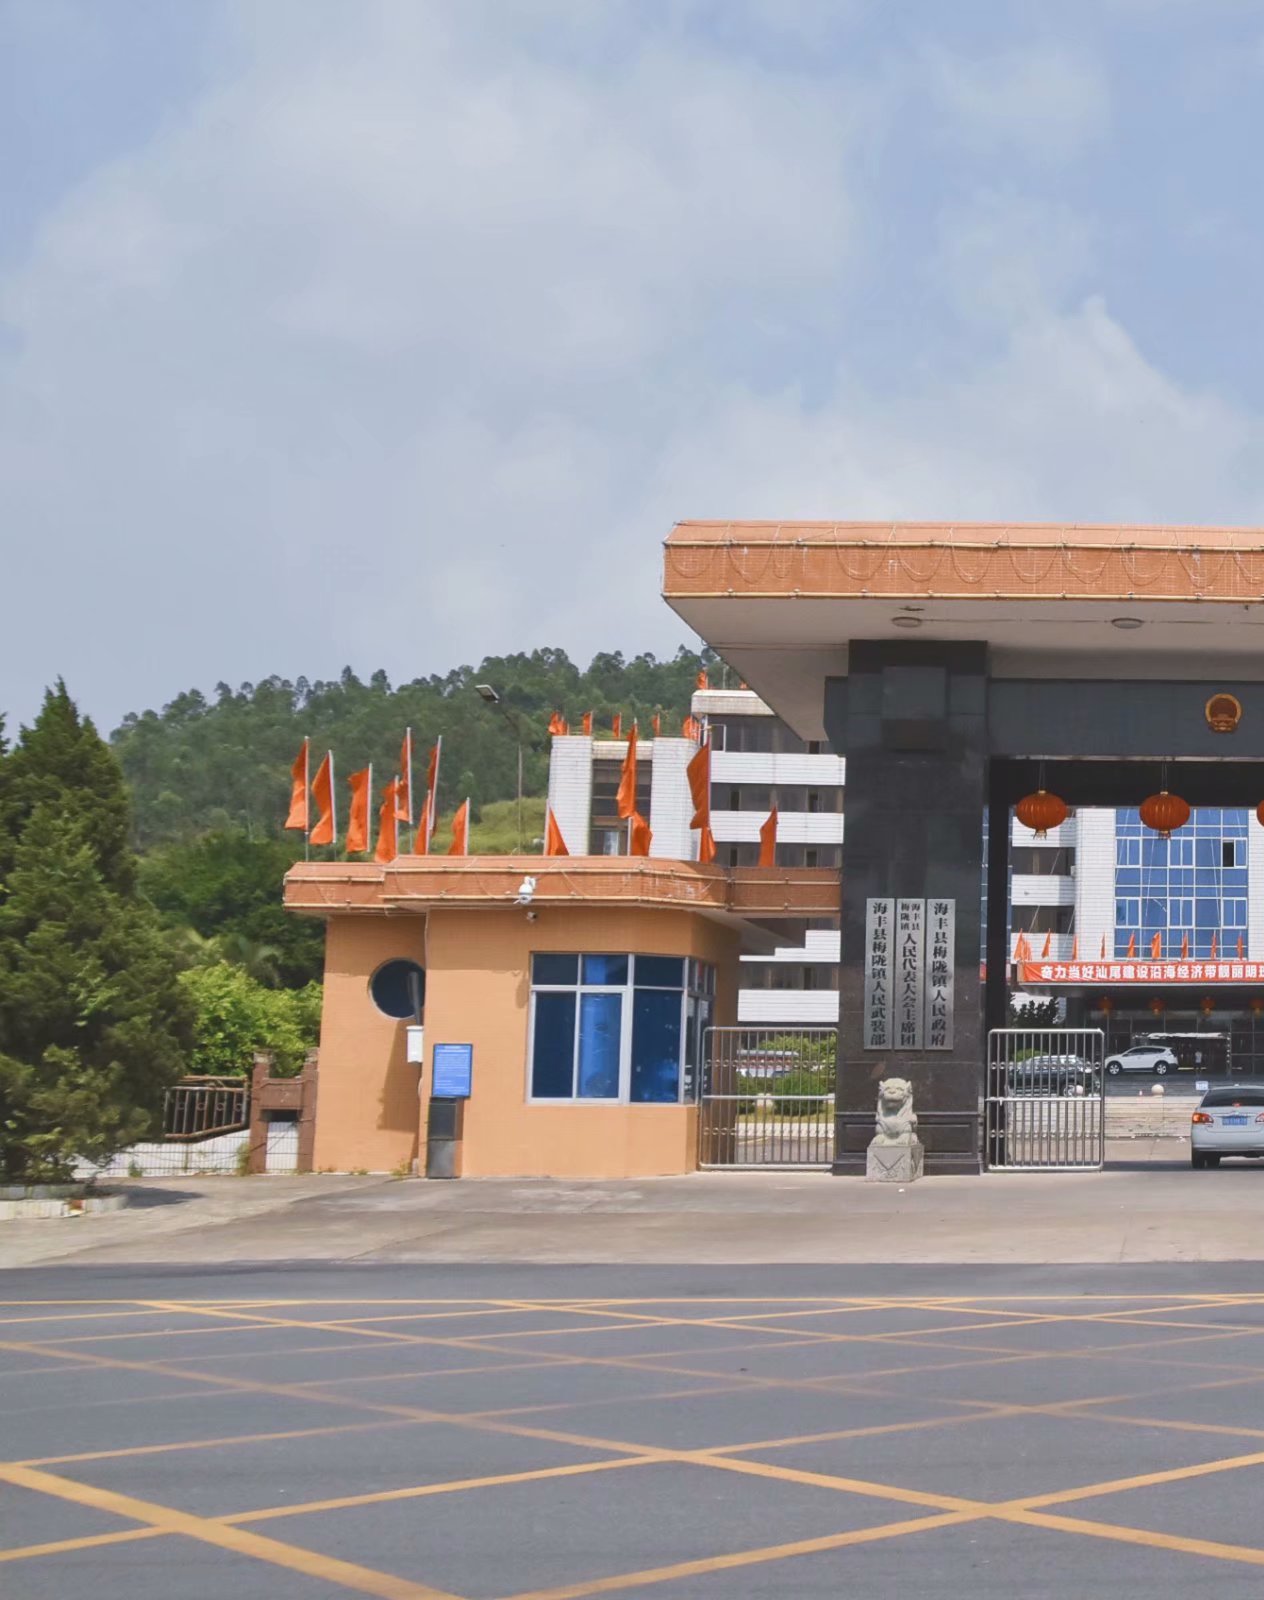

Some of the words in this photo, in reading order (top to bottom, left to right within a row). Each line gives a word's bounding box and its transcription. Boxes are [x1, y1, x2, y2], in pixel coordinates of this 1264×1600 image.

[870, 901, 888, 1047] 海丰县梅陇镇人民武装部
[900, 932, 918, 1047] 人民代表大会主席团
[930, 901, 949, 1046] 海丰县梅陇镇人民政府
